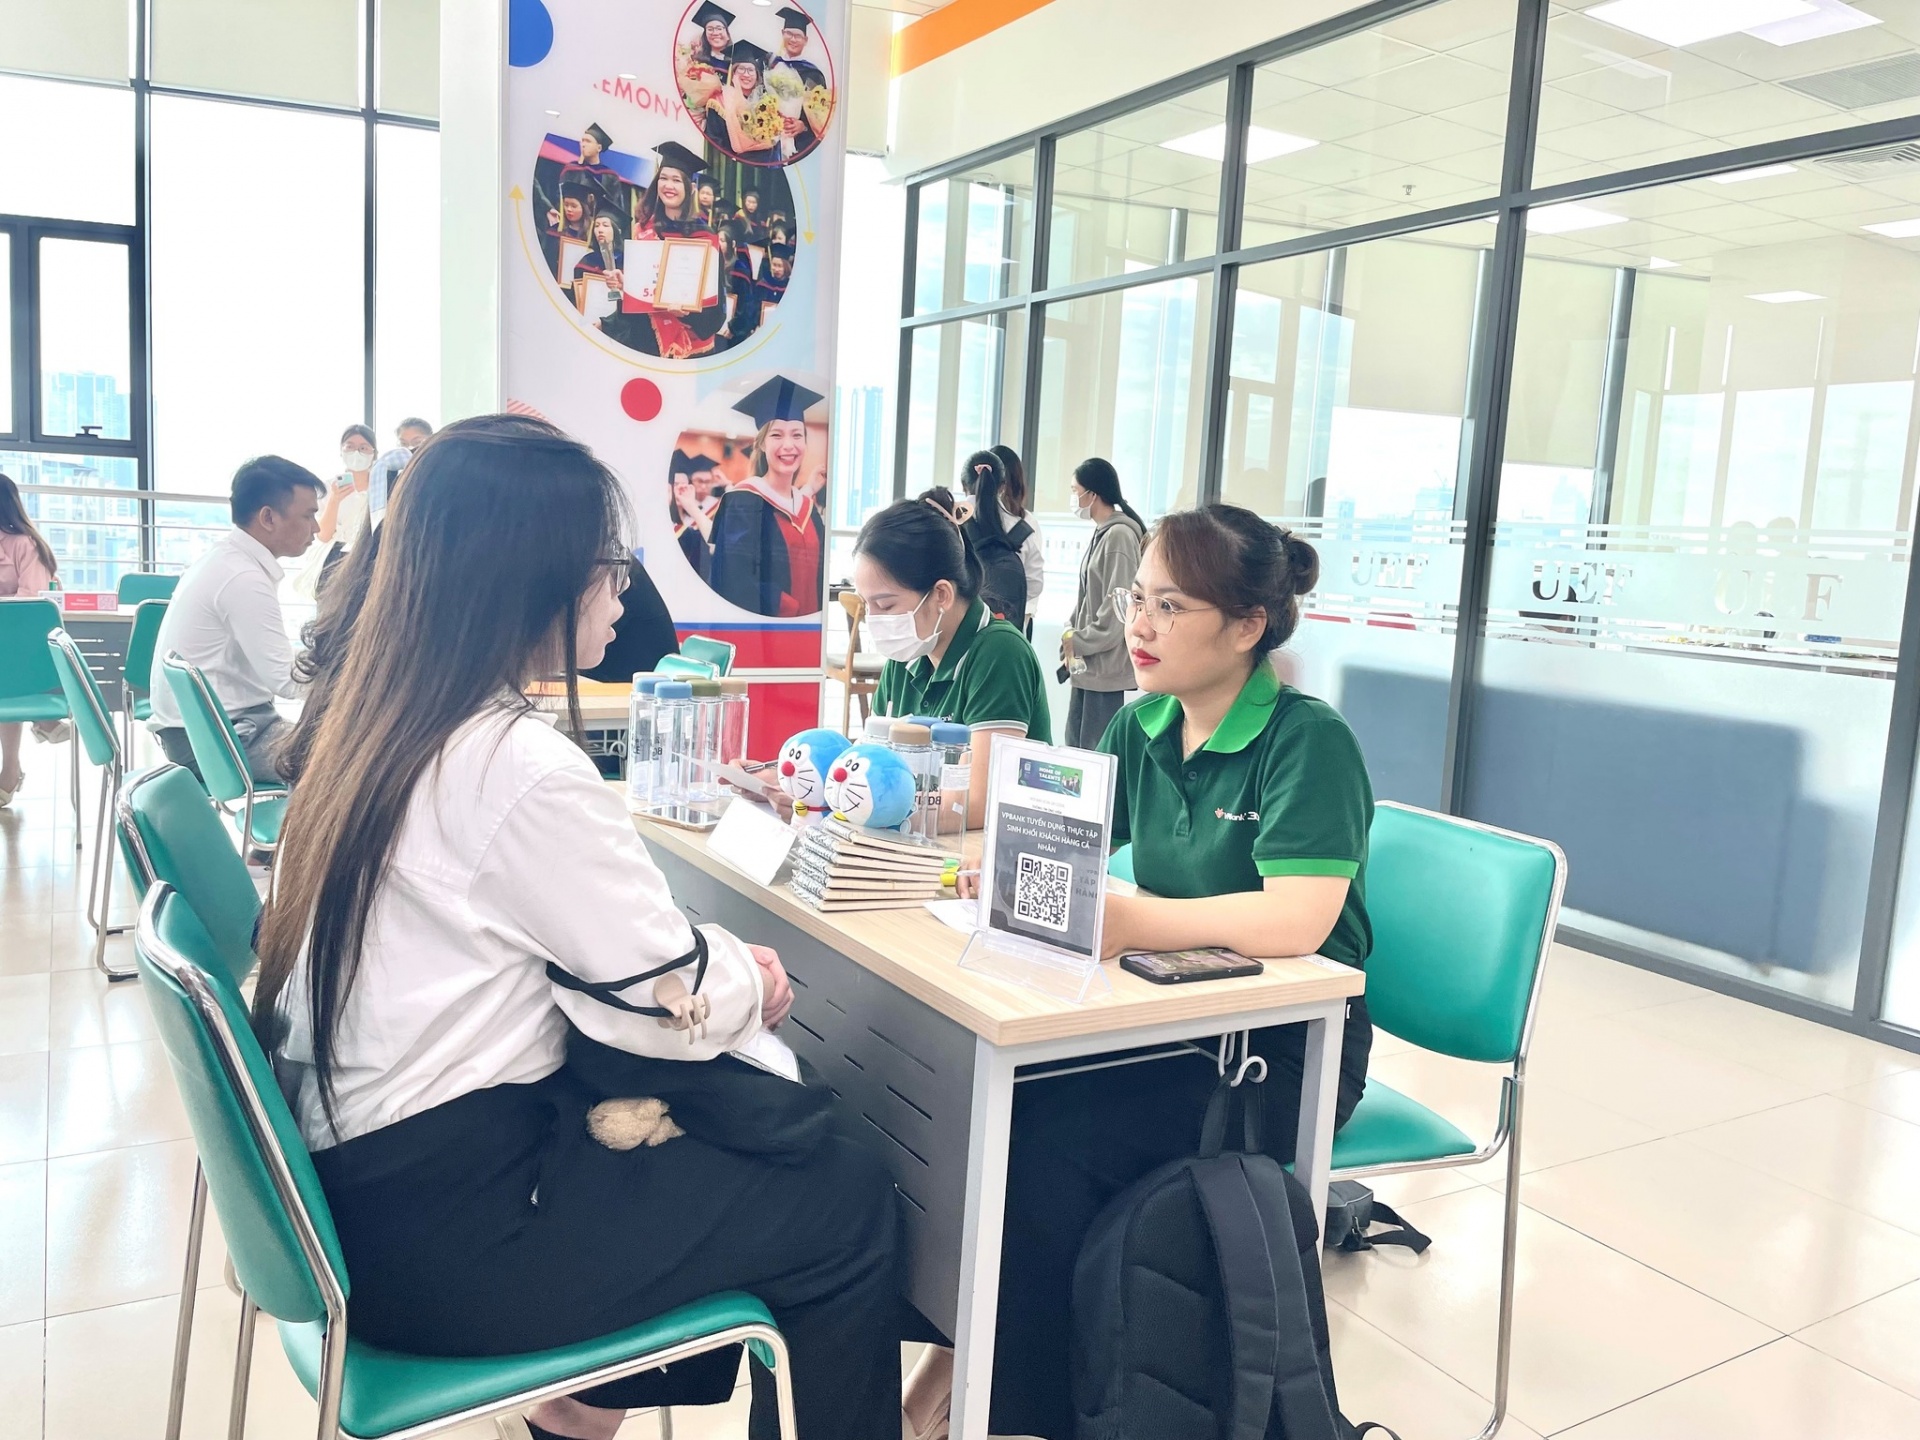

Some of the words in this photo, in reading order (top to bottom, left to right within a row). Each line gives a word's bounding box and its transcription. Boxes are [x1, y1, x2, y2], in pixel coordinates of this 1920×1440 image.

[593, 77, 682, 122] EMONY
[1351, 551, 1428, 590] UEF
[1532, 559, 1633, 606] UEF
[1038, 772, 1061, 782] TALENTS
[1001, 811, 1026, 823] VPBANK
[1047, 821, 1066, 832] DỤNG
[1066, 825, 1085, 837] THỰC
[1085, 829, 1098, 840] TẬP
[1006, 824, 1021, 834] SINH
[1038, 830, 1060, 843] KHÁCH
[1061, 836, 1080, 848] HÀNG
